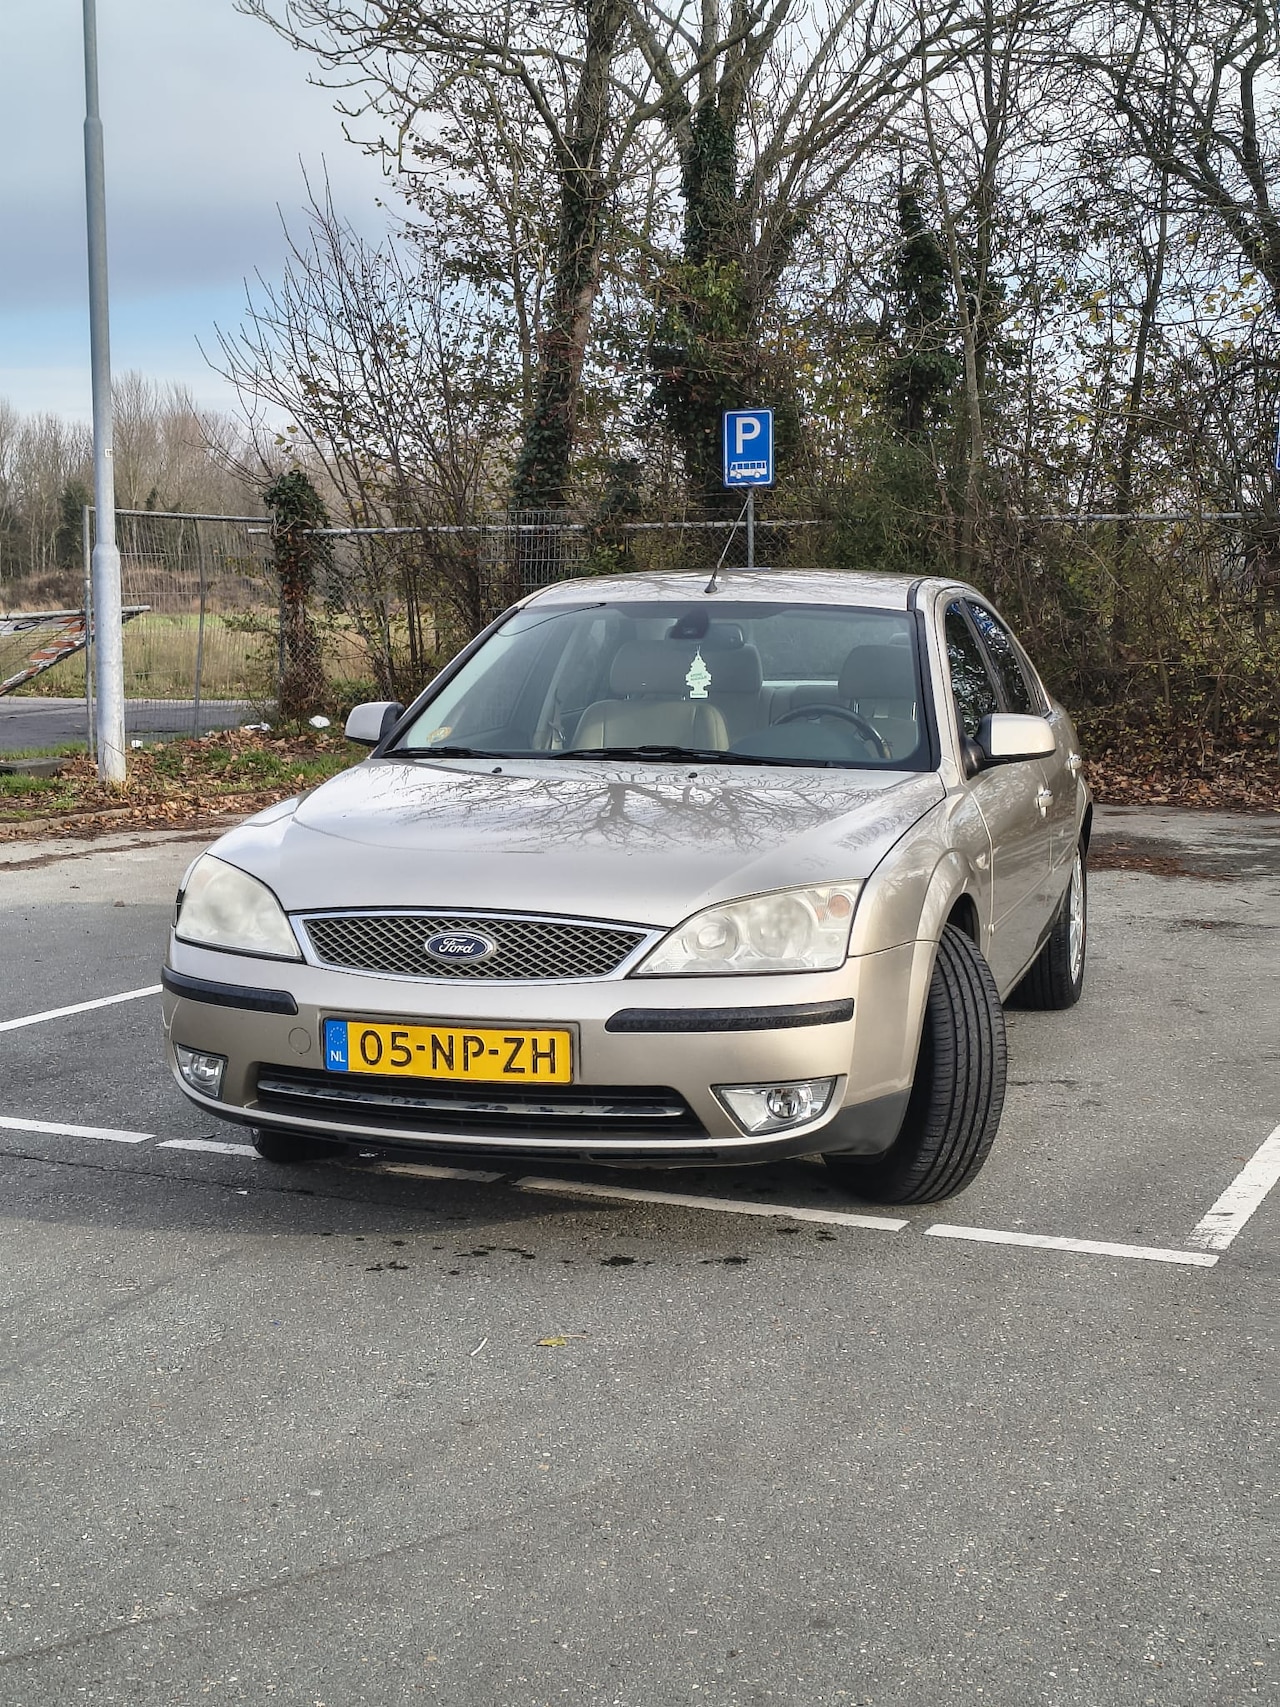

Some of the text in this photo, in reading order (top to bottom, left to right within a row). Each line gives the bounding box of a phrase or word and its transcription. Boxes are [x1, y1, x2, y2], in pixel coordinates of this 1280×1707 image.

[736, 417, 760, 454] P
[439, 938, 475, 954] Ford
[331, 1050, 346, 1062] NL
[360, 1029, 556, 1074] 05-NP-ZH
